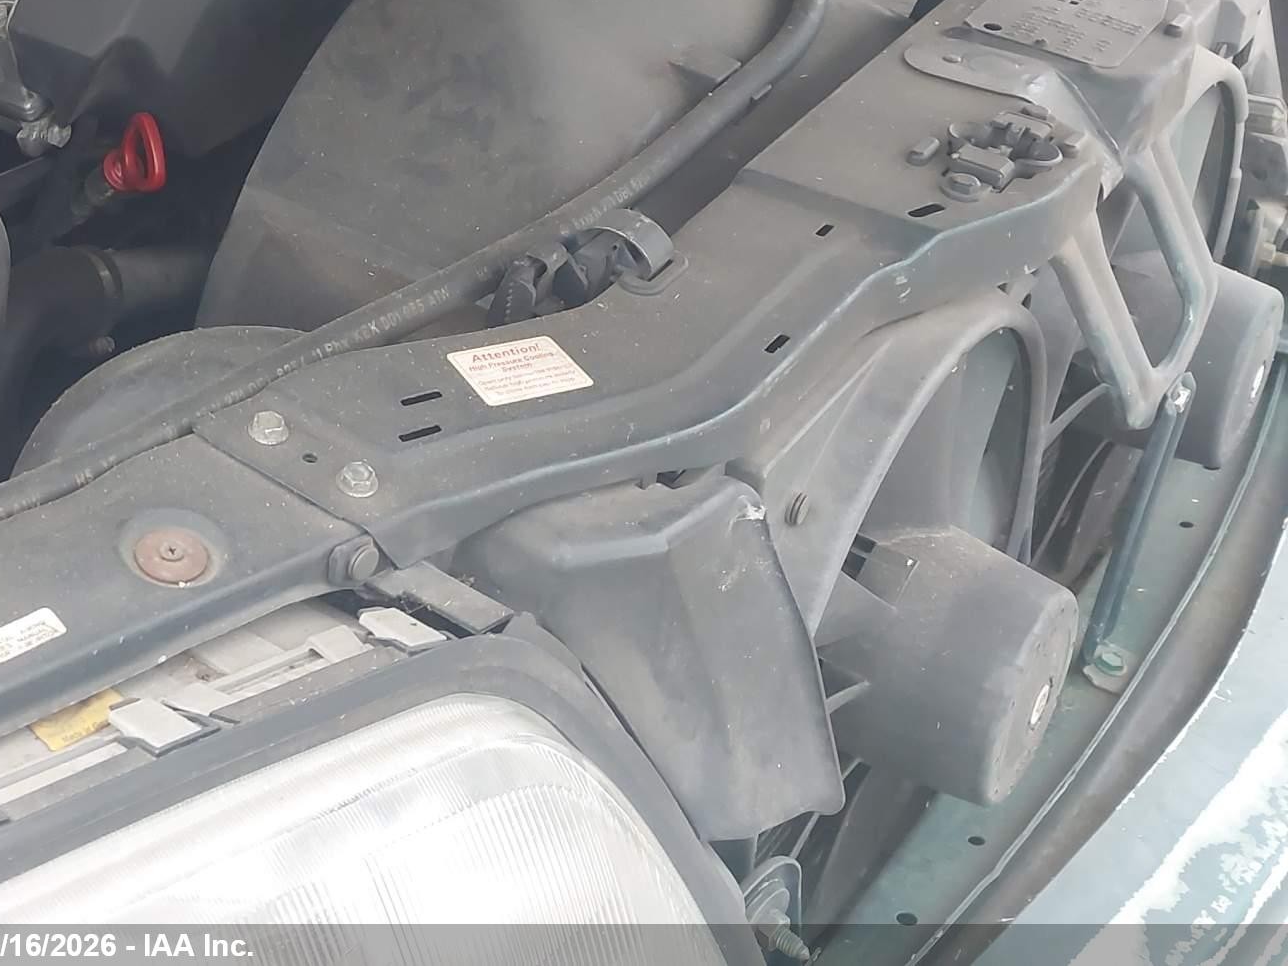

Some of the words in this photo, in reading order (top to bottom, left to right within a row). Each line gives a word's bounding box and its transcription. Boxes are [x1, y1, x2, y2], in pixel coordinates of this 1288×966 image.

[471, 343, 541, 363] Attention!
[468, 363, 488, 372] High
[487, 357, 522, 370] Pressure
